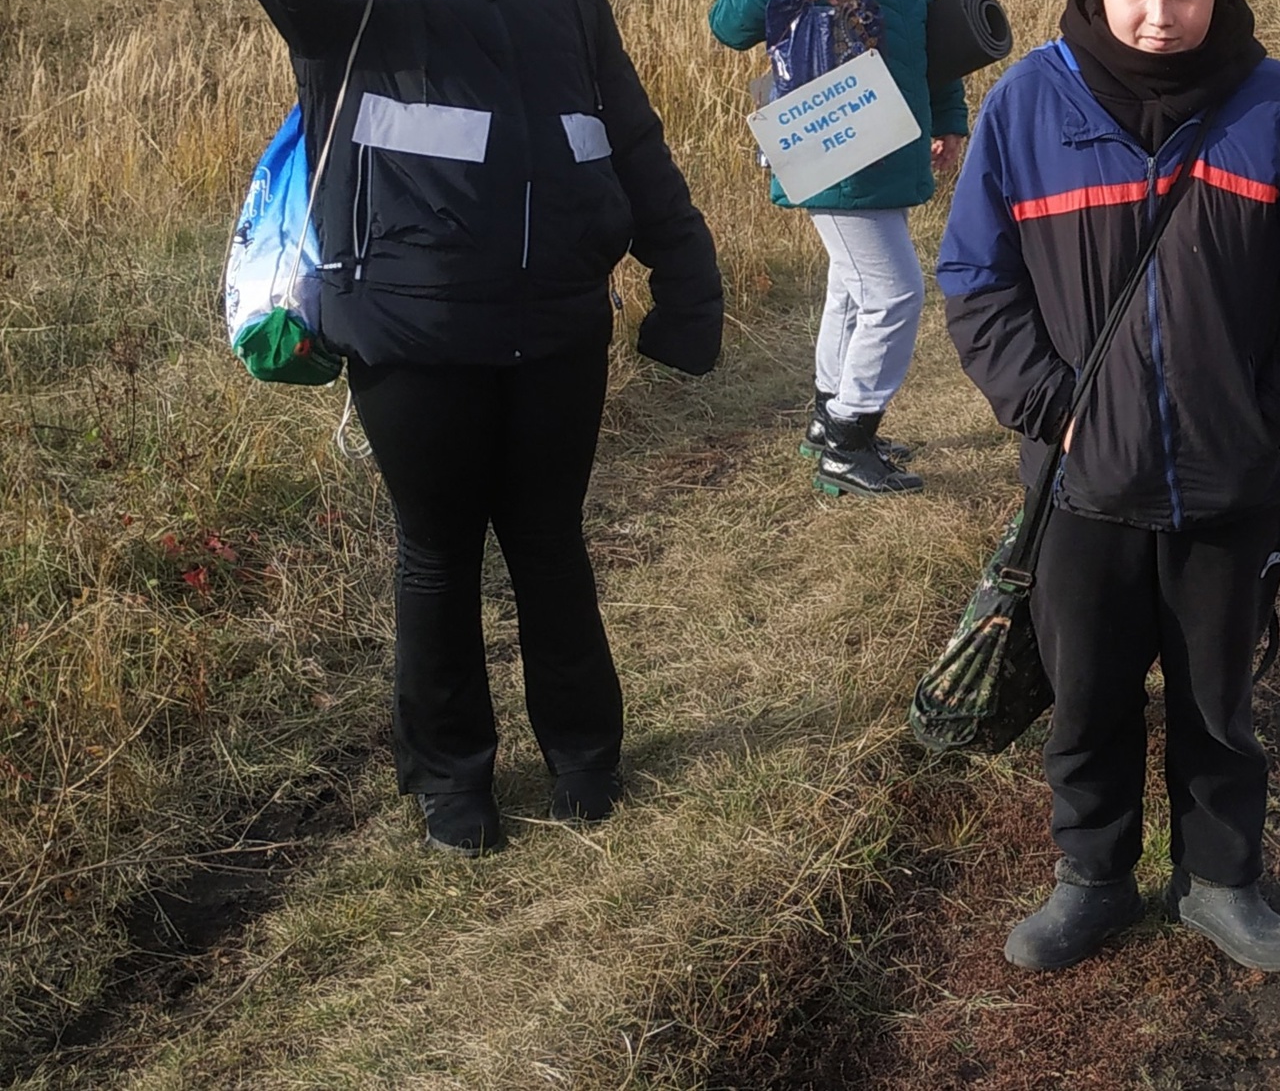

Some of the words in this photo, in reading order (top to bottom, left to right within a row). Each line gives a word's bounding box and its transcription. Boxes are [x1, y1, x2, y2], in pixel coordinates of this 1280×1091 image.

[778, 75, 858, 125] СПАСИБО
[779, 132, 803, 151] ЗА
[804, 89, 878, 135] ЧИСТЫЙ
[821, 126, 857, 153] ЛЕС
